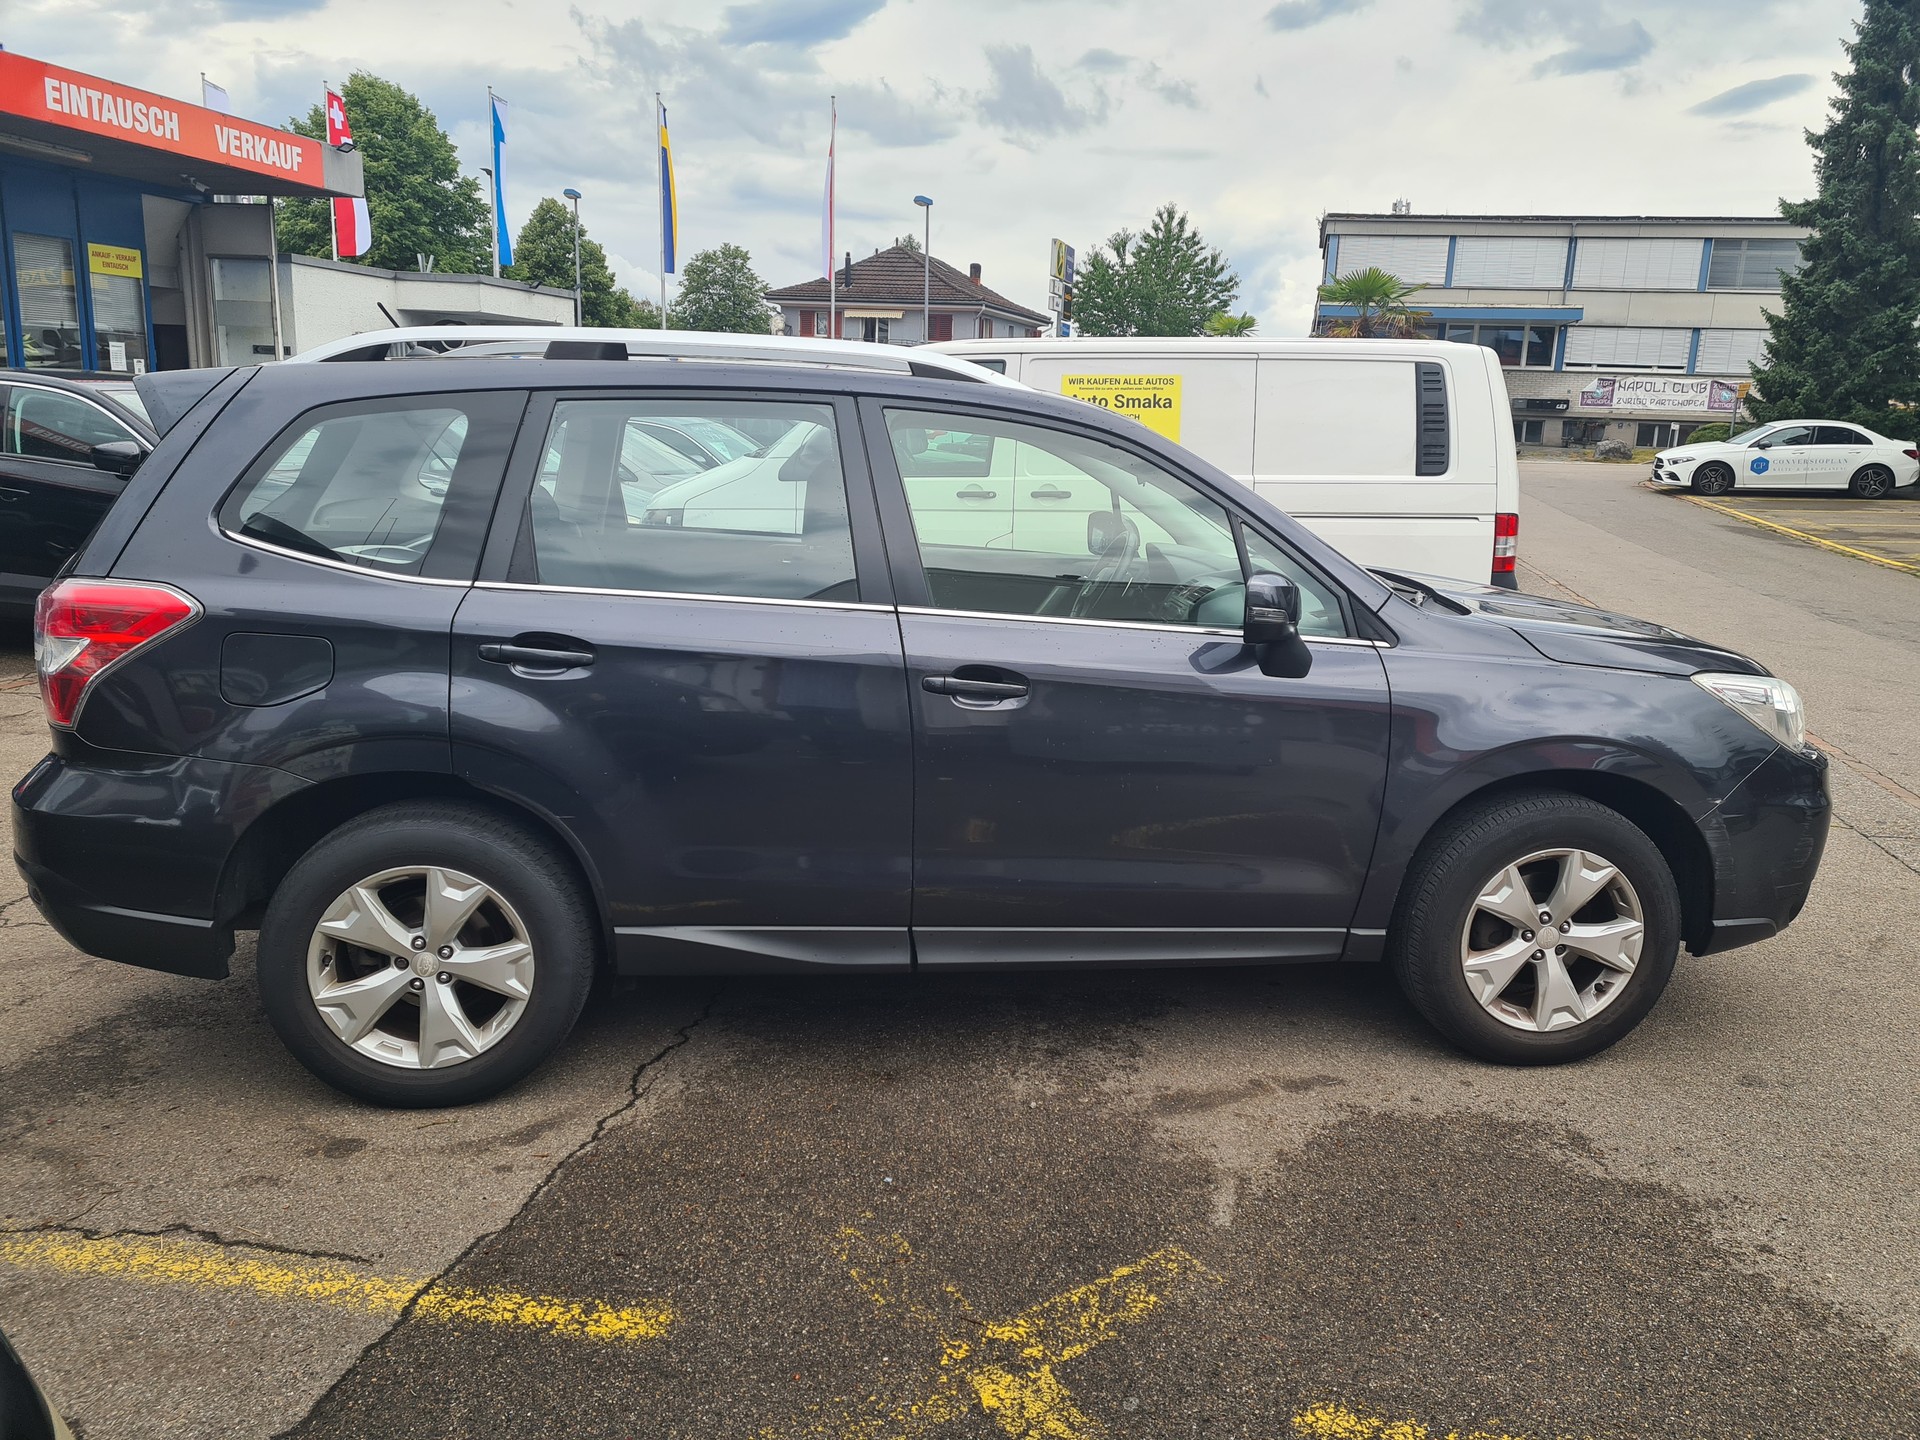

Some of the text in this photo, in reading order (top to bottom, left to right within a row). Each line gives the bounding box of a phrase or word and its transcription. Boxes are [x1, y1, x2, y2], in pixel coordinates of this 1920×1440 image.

[44, 77, 303, 172] EINTAUSCH VERKAUF
[91, 250, 111, 259] ANKAUF
[115, 253, 137, 263] VERKAUF
[102, 261, 129, 271] EINTAUSCH
[1068, 378, 1175, 386] WIR KAUFEN ALLE AUTOS
[1617, 381, 1668, 393] NAPOLI
[1072, 393, 1173, 409] to Smaka
[1753, 461, 1766, 470] CP
